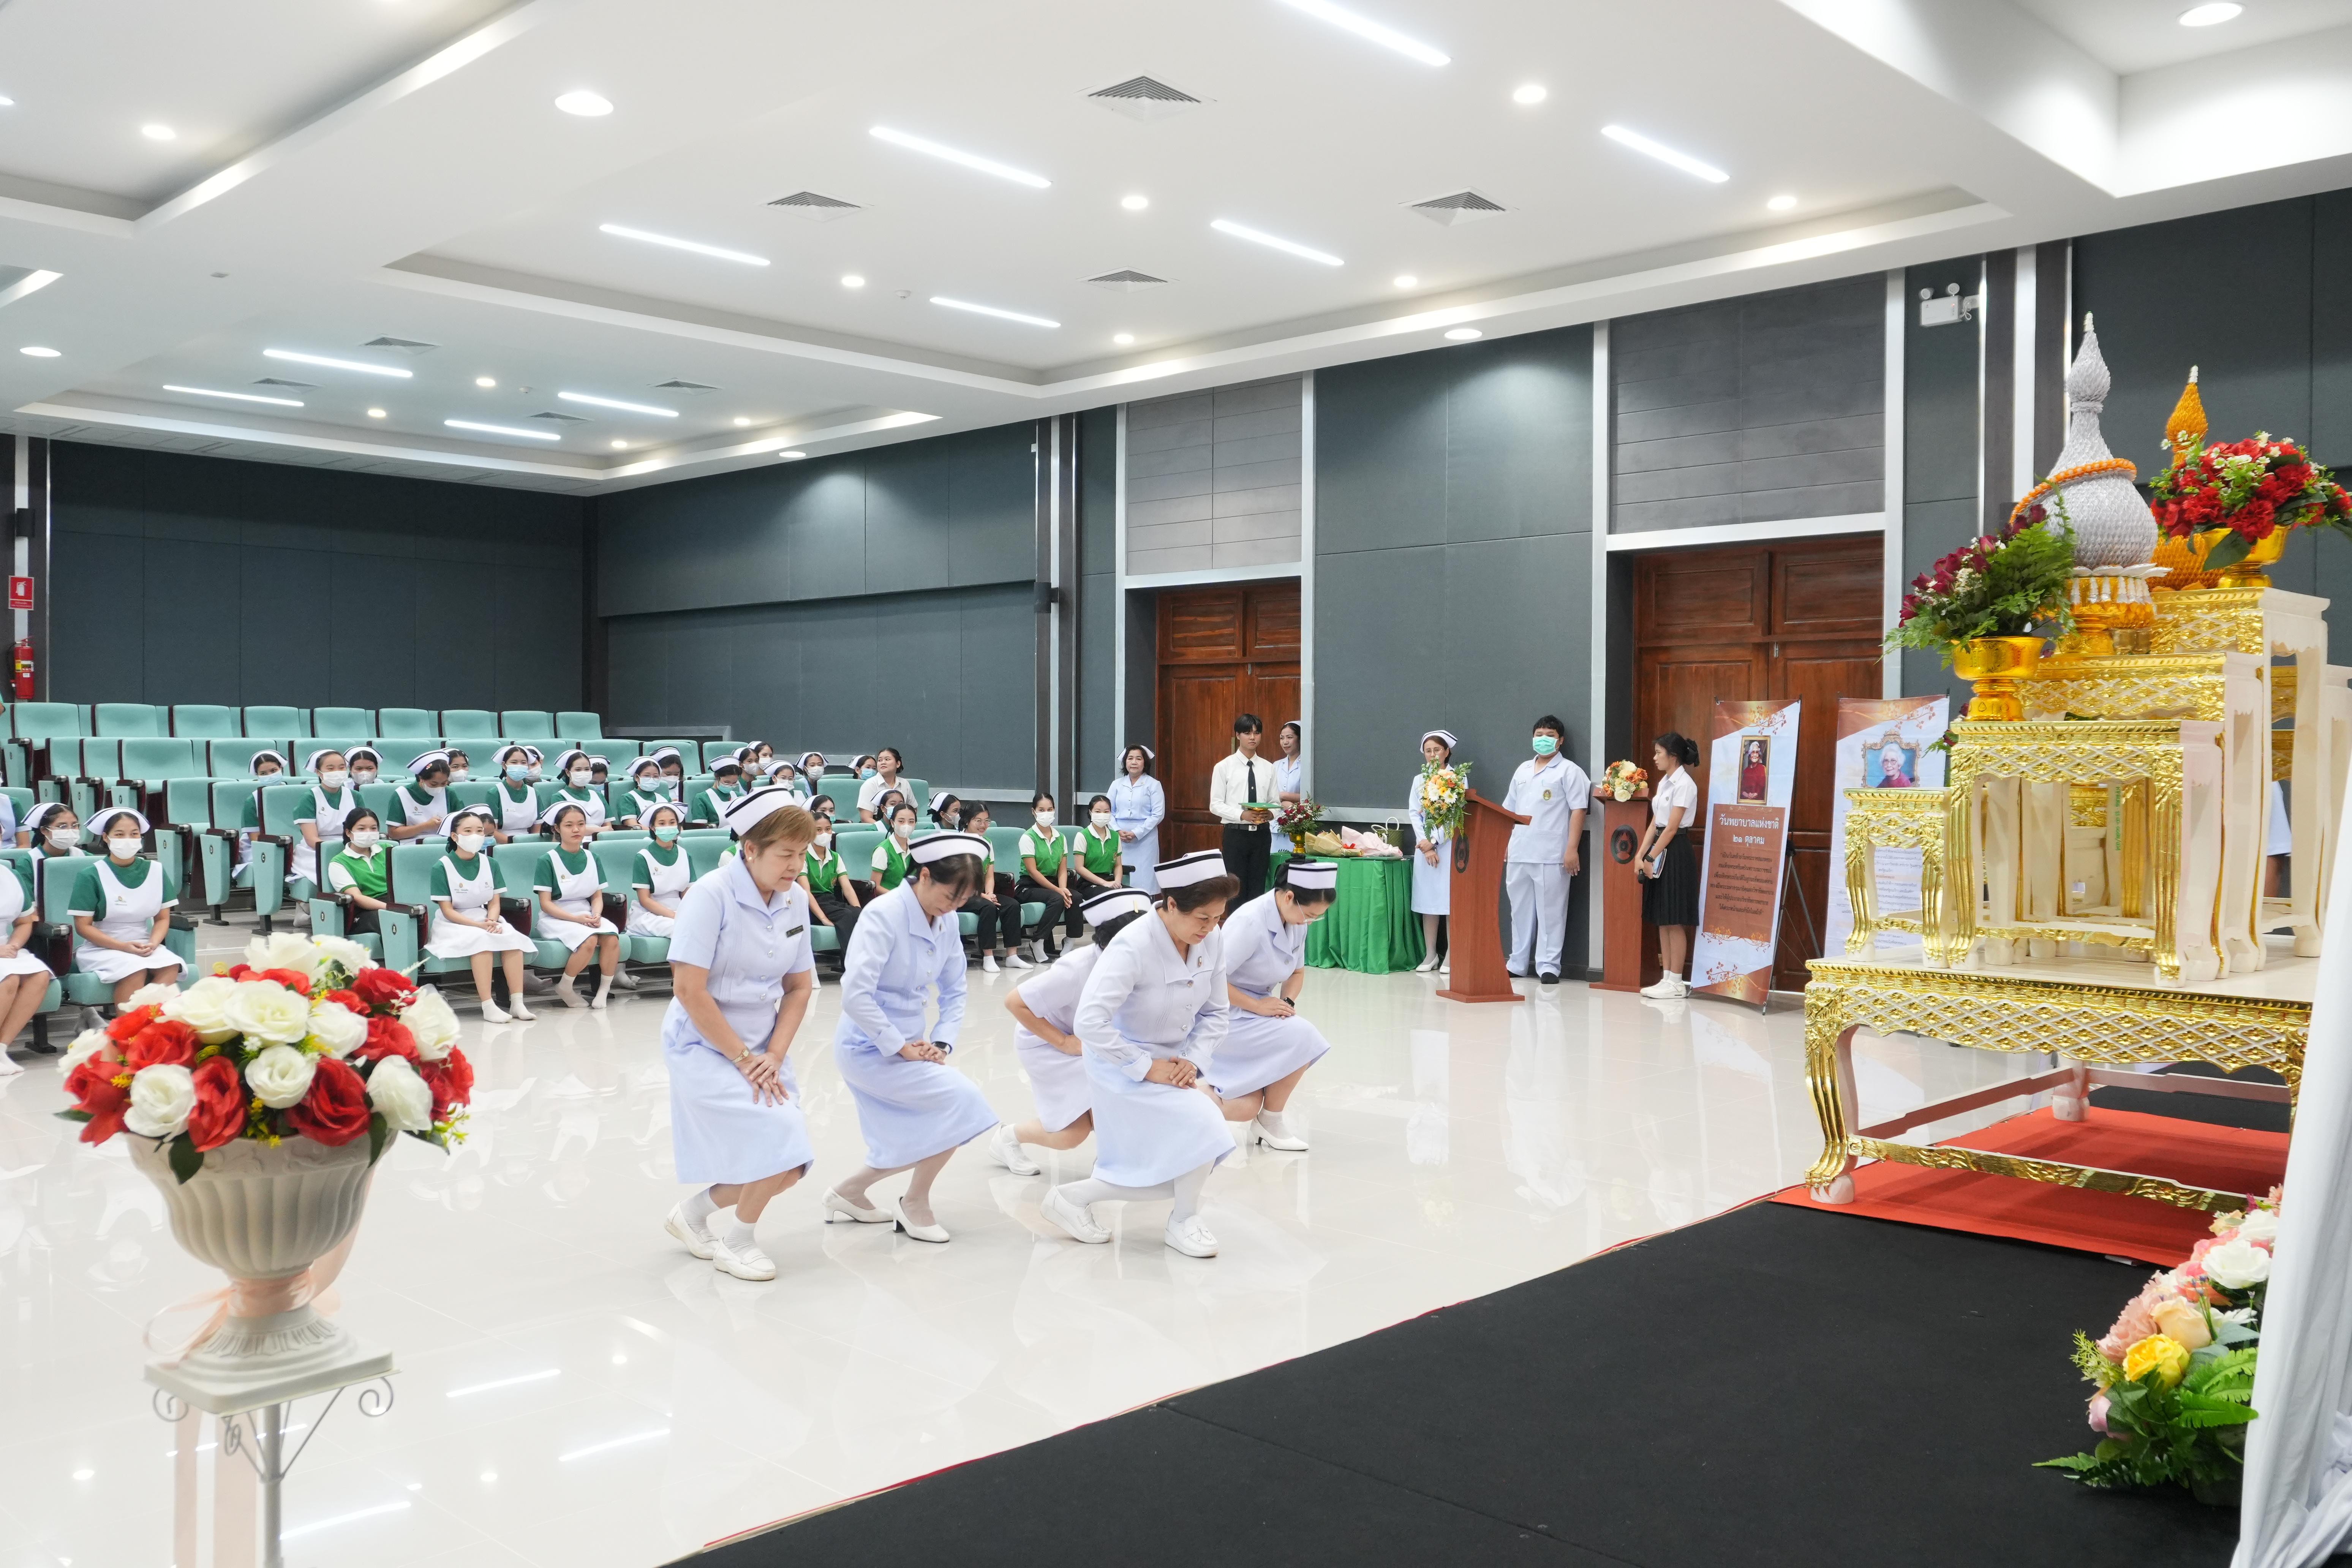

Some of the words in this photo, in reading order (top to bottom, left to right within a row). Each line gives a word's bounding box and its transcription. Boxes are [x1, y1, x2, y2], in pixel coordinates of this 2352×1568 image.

[1720, 813, 1779, 829] วันพยาบาลแห่งชาติ
[1745, 836, 1765, 847] ตุลาคม
